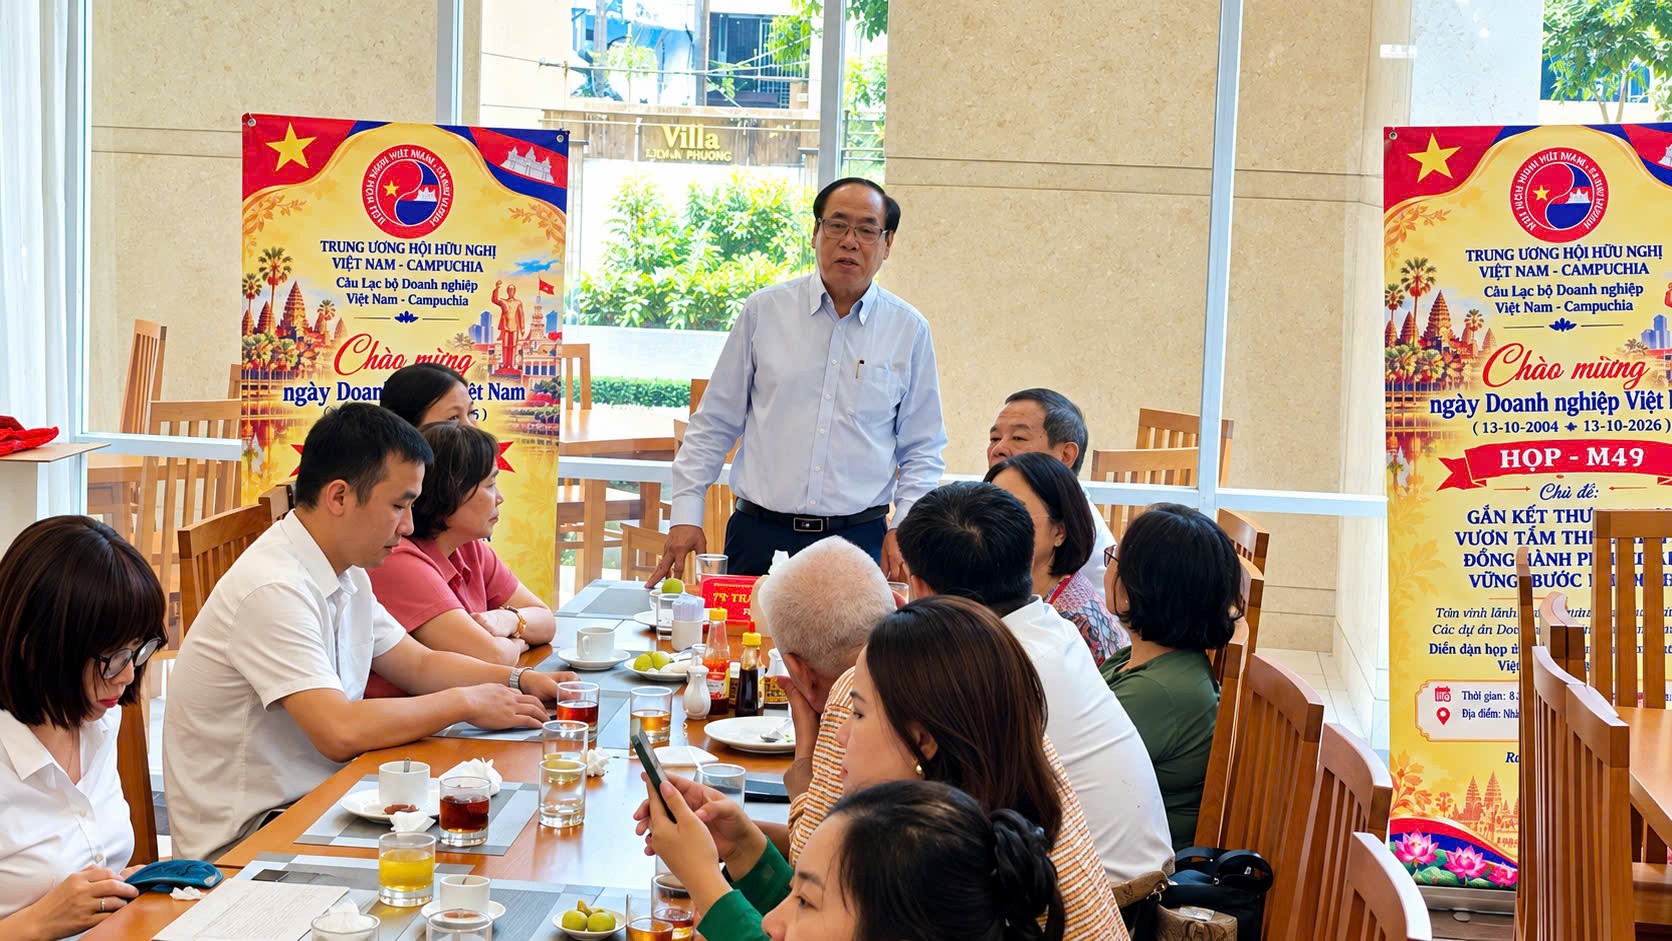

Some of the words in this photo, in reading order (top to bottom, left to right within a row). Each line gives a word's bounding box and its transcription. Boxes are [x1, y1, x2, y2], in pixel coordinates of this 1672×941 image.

[661, 123, 720, 150] Villa
[320, 240, 365, 253] TRUNG
[368, 240, 405, 254] ƯƠNG
[409, 241, 432, 257] HỘI
[434, 242, 462, 256] HỮU
[465, 244, 497, 260] NGHỊ
[1465, 249, 1515, 262] TRUNG
[1518, 246, 1560, 261] ƯƠNG
[1563, 245, 1589, 262] HỘI
[1592, 243, 1622, 259] HỮU
[1626, 245, 1663, 260] NGHỊ
[332, 255, 362, 272] VIỆT
[365, 257, 396, 270] NAM
[406, 259, 484, 273] CAMPUCHIA
[1479, 263, 1512, 281] VIỆT
[1515, 265, 1549, 278] NAM
[1561, 262, 1650, 277] CAMPUCHIA
[361, 277, 382, 292] Lạc
[401, 279, 438, 290] Doanh
[440, 279, 478, 293] nghiệp
[1511, 285, 1534, 300] Lạc
[1556, 283, 1598, 296] Doanh
[1600, 282, 1644, 297] nghiệp
[346, 293, 370, 307] Việt
[372, 293, 398, 305] Nam
[407, 294, 469, 308] Campuchia
[1495, 301, 1521, 315] Việt
[1524, 301, 1553, 314] Nam
[1563, 299, 1634, 314] Campuchia
[333, 333, 407, 376] Chào
[1482, 342, 1565, 388] Chào
[283, 381, 331, 407] ngày
[336, 381, 387, 402] Doan
[488, 383, 526, 401] Nam
[1430, 393, 1480, 419] ngày
[1485, 391, 1549, 413] Doanh
[1554, 391, 1620, 416] nghiệp
[1624, 390, 1664, 416] Việt
[1500, 448, 1562, 472] HỌP
[1586, 447, 1645, 467] M49
[1511, 504, 1549, 524] KẾT
[1552, 506, 1594, 524] THƯ
[1454, 529, 1508, 546] VƯƠN
[1469, 570, 1518, 588] VỮNG
[1531, 570, 1582, 588] BƯỚC
[1432, 623, 1455, 635] Các
[1484, 643, 1508, 657] họp
[1483, 691, 1506, 703] gian:
